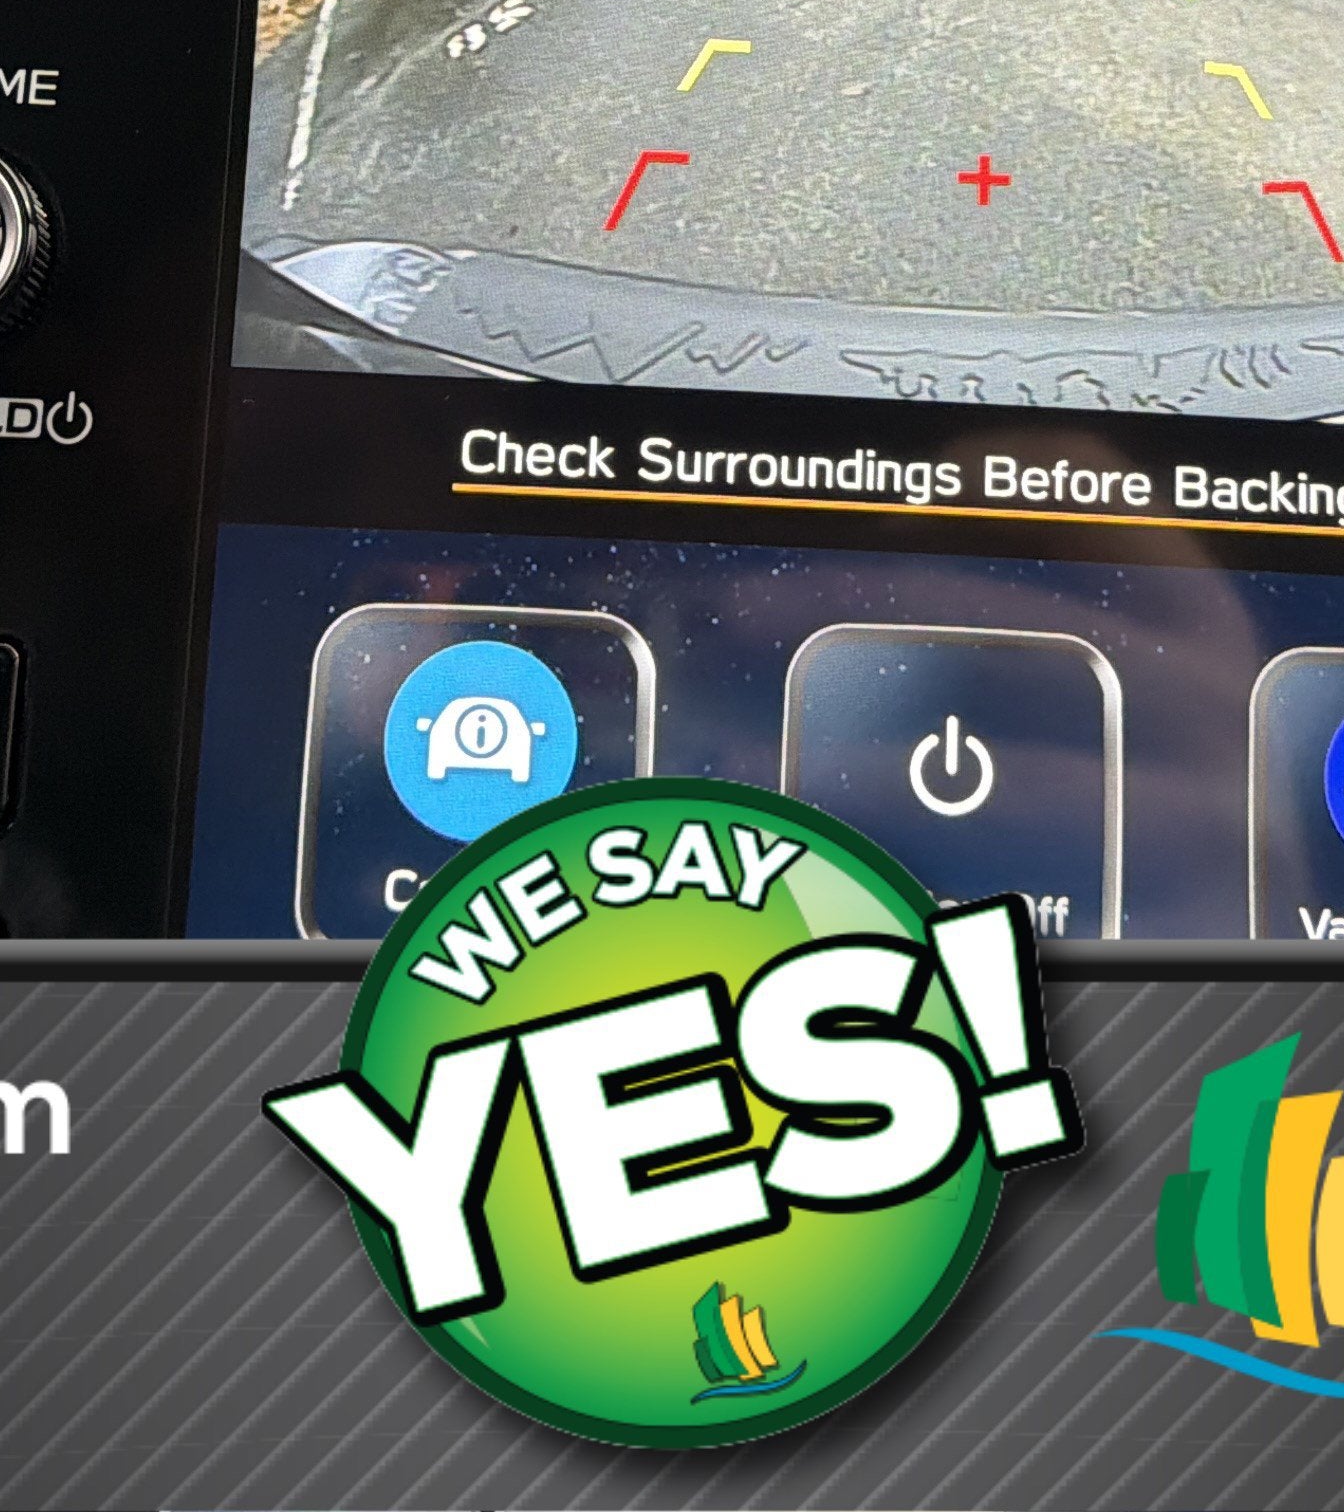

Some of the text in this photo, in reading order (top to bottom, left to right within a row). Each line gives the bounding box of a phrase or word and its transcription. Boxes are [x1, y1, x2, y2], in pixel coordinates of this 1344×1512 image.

[460, 428, 617, 480] Check
[637, 437, 962, 505] Surroundings
[983, 455, 1152, 506] Before
